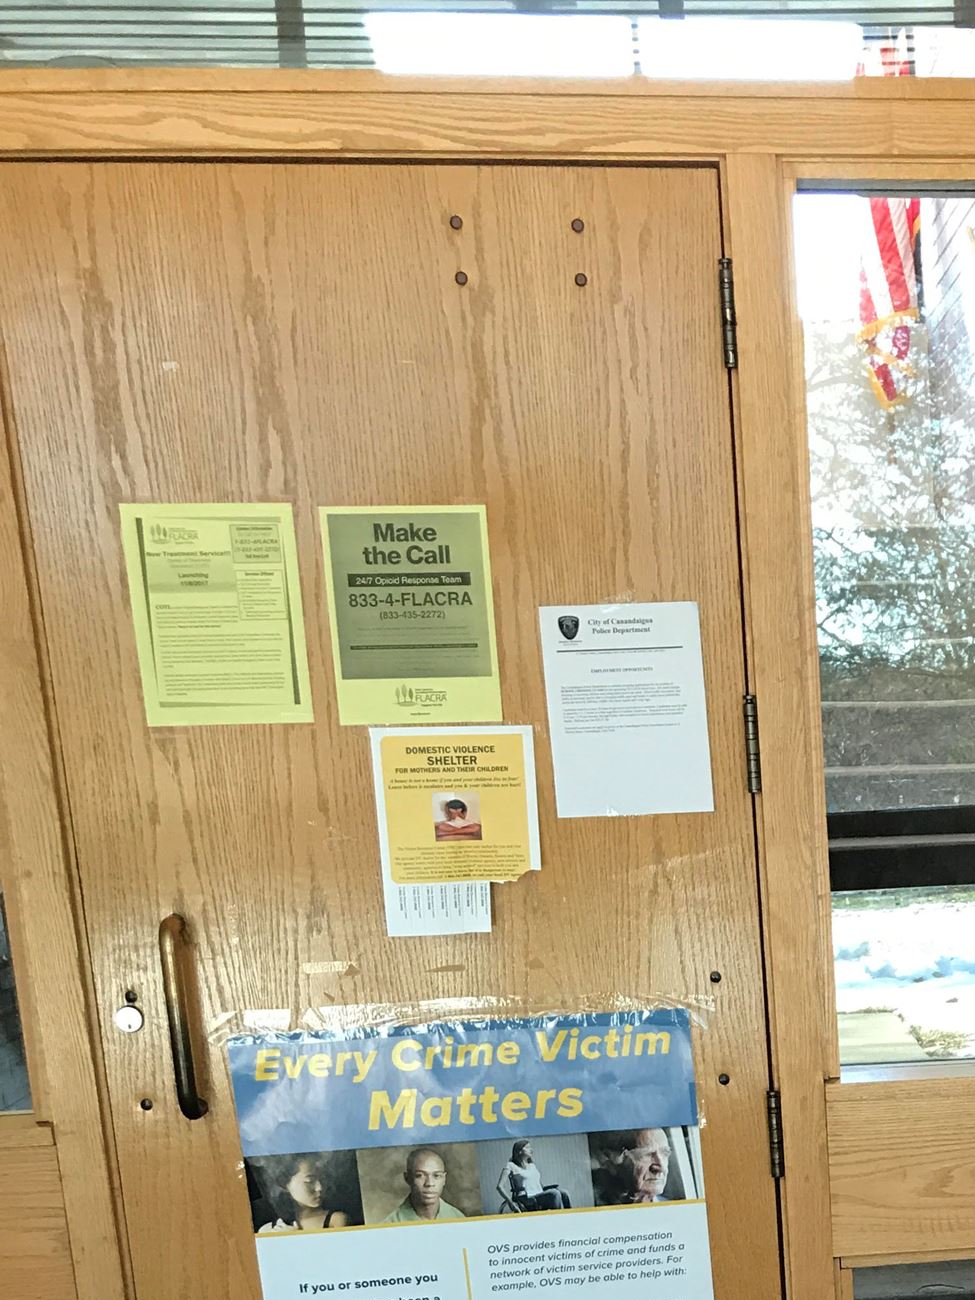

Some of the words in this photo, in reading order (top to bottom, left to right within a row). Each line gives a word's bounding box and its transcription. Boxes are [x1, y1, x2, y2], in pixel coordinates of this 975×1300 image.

[373, 523, 437, 542] Make
[362, 546, 401, 565] the
[406, 545, 451, 565] Call
[375, 577, 399, 585] Opioid
[402, 576, 439, 584] Response
[349, 591, 473, 607] 833-4-FLACRA
[380, 610, 445, 620] (833-435-2272)
[611, 618, 653, 626] Canandaigua
[612, 626, 650, 634] Department
[406, 746, 450, 754] DOMESTIC
[453, 745, 495, 753] VIOLENCE
[427, 756, 477, 766] SHELTER
[255, 1047, 377, 1083] Every
[392, 1035, 520, 1072] Crime
[536, 1025, 671, 1062] Victim
[368, 1086, 583, 1131] Matters
[488, 1244, 510, 1254] OVS
[513, 1241, 555, 1253] provides
[558, 1237, 600, 1248] financial
[603, 1232, 672, 1245] compensation
[489, 1258, 499, 1267] to
[502, 1255, 545, 1266] innocent
[547, 1251, 582, 1261] victims
[585, 1249, 595, 1258] of
[598, 1248, 624, 1257] crime
[627, 1246, 646, 1255] and
[649, 1243, 675, 1253] funds
[490, 1268, 530, 1279] network
[534, 1266, 545, 1274] of
[546, 1264, 574, 1273] victim
[578, 1261, 612, 1271] service
[616, 1257, 663, 1270] providers.
[667, 1255, 682, 1264] For
[300, 1283, 308, 1293] If
[312, 1283, 334, 1295] you
[338, 1282, 351, 1291] or
[355, 1276, 411, 1288] someone
[415, 1273, 438, 1285] you
[492, 1281, 537, 1292] example,
[540, 1278, 561, 1287] OVS
[564, 1277, 585, 1286] may
[588, 1274, 600, 1283] be
[604, 1272, 624, 1281] able
[640, 1269, 661, 1279] help
[664, 1267, 687, 1276] with:
